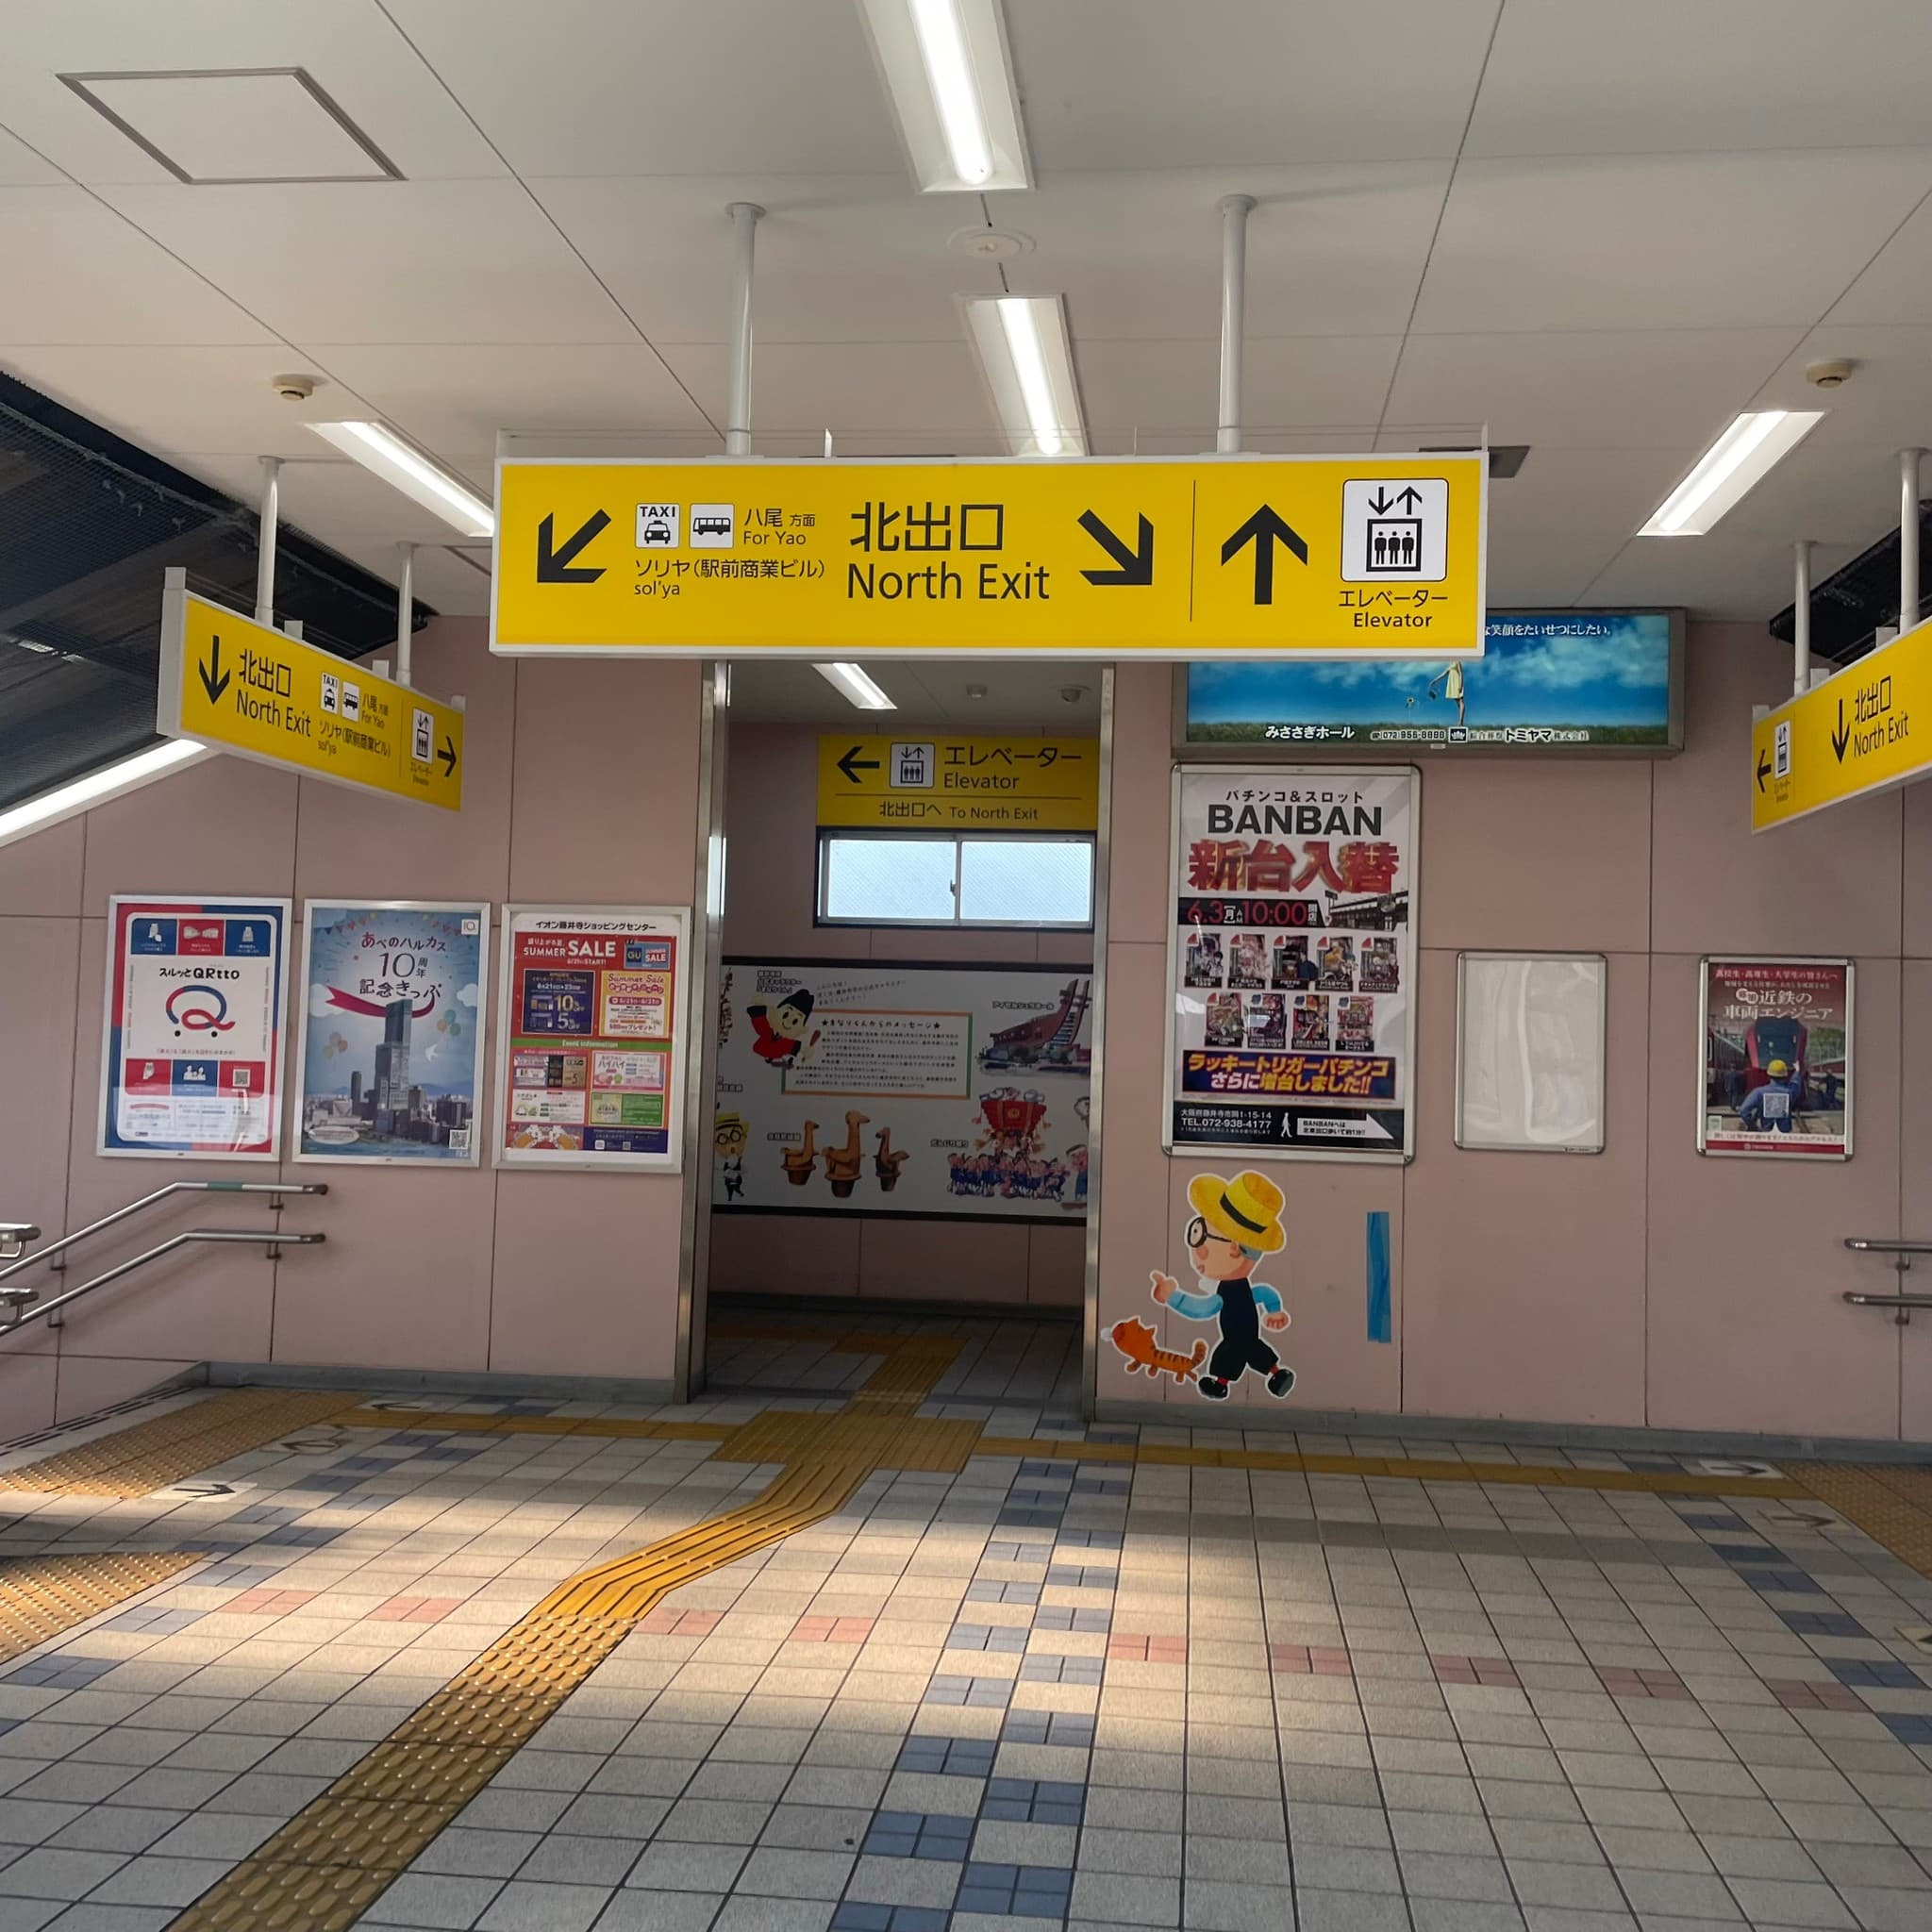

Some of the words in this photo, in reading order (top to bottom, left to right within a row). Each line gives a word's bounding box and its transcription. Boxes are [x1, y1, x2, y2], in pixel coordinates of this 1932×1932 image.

[640, 507, 676, 516] TAXI
[743, 508, 783, 527] 八尾
[789, 513, 816, 527] 方面
[850, 502, 1004, 552] 北出口
[743, 530, 769, 545] For
[774, 530, 807, 545] Yao
[848, 562, 962, 599] North
[978, 562, 1050, 600] Exit
[1339, 590, 1449, 608] エレベーター
[1353, 612, 1433, 628] Elevator
[239, 648, 291, 697] 北出口
[323, 675, 338, 688] TAXI
[1855, 675, 1891, 724] 北出口
[236, 689, 281, 728] North
[286, 707, 310, 737] Exit
[361, 711, 373, 723] For
[373, 714, 385, 729] Yao
[1265, 724, 1355, 741] みささぎホール
[1854, 723, 1884, 758] North
[1888, 711, 1909, 743] Exit
[944, 746, 1082, 768] エレベーター
[943, 773, 1020, 790] Elevator
[879, 802, 942, 817] 北出口へ
[950, 807, 966, 819] To
[971, 808, 1009, 820] North
[1014, 808, 1038, 820] Exit
[1208, 804, 1382, 836] BANBAN
[1188, 839, 1400, 894] 新台入替
[361, 931, 446, 952] あべのハルカス
[524, 946, 566, 957] SUMMER
[567, 940, 616, 958] SALE
[644, 953, 666, 962] SALE
[359, 979, 442, 999] 記念きっぷ
[1759, 990, 1812, 1006] 近鉄の
[1724, 1005, 1834, 1020] 車両エンジニア
[1188, 1054, 1390, 1077] ラッキートリガーパチンコ
